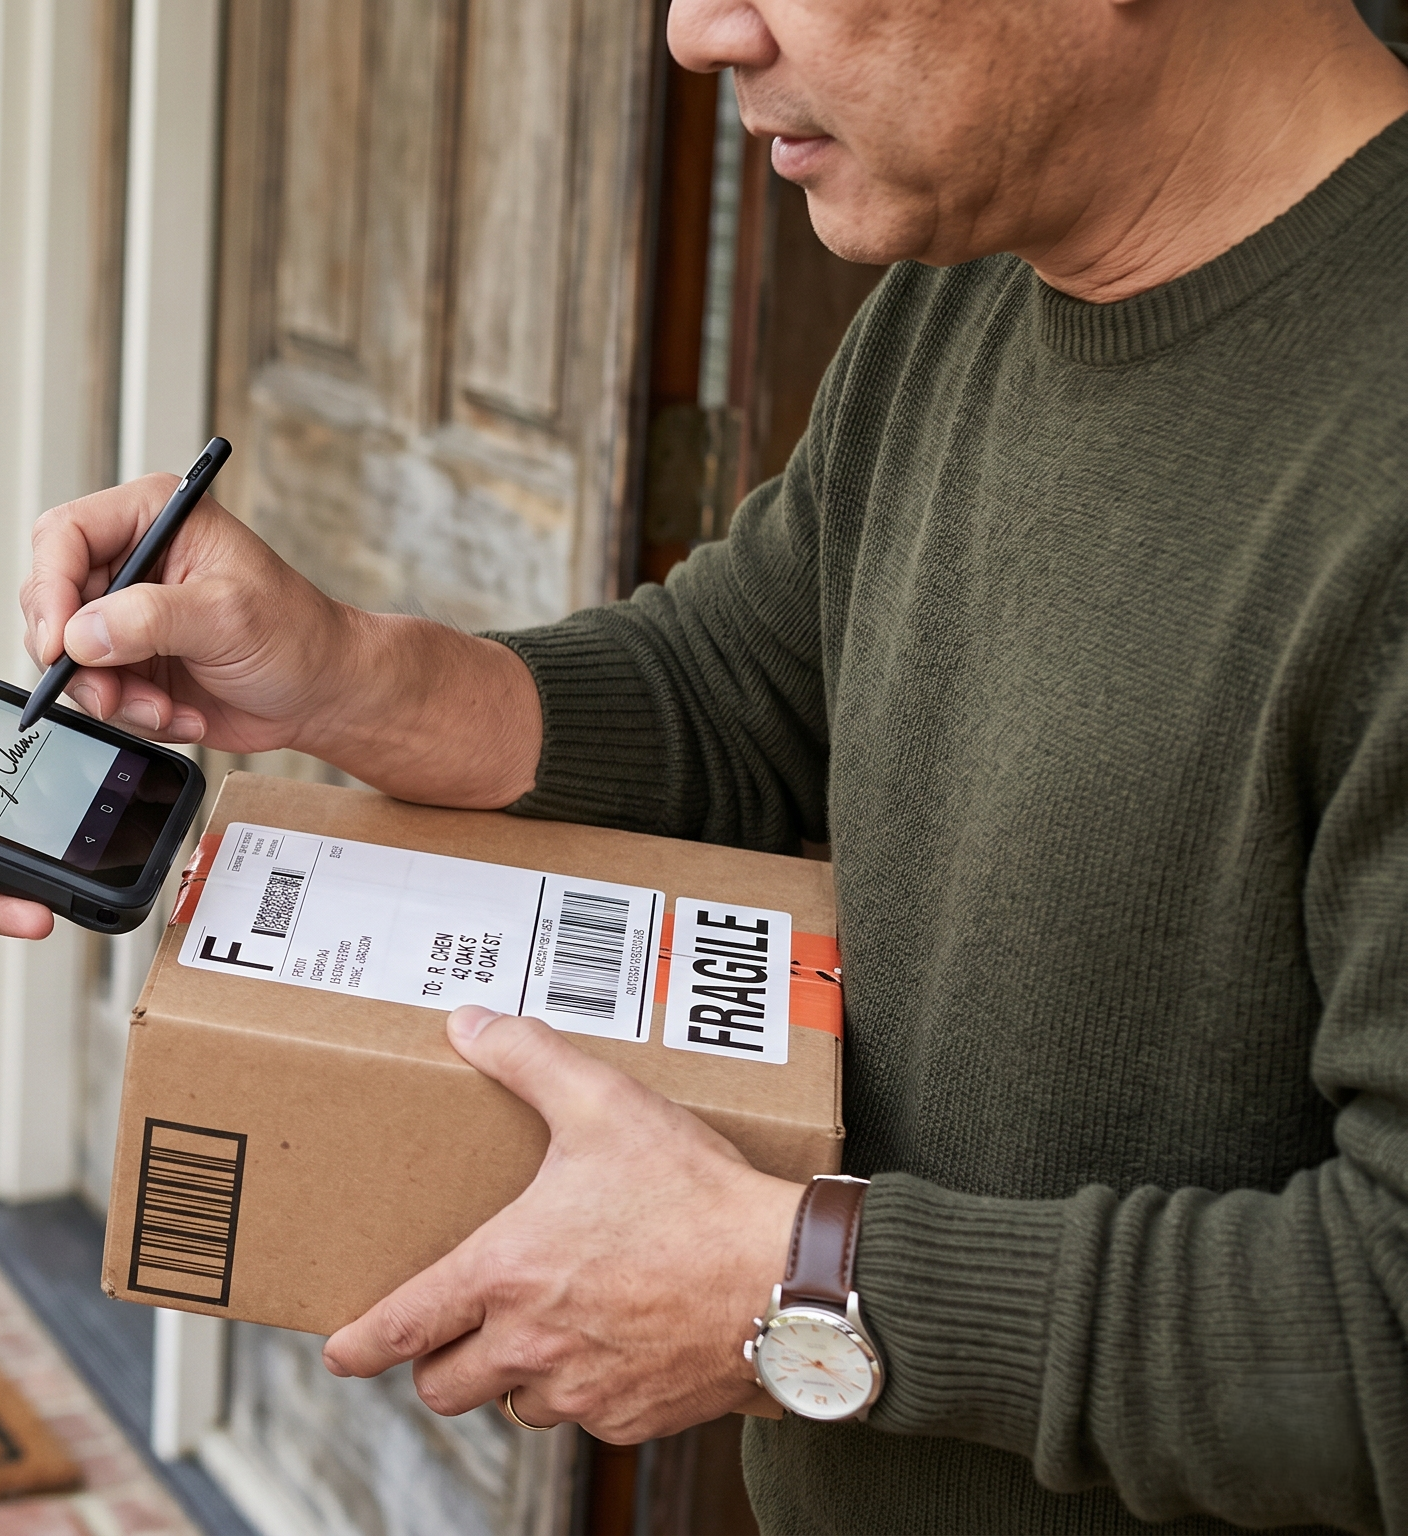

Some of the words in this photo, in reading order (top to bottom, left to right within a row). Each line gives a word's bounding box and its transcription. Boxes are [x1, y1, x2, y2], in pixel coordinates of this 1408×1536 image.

[199, 935, 274, 972] F
[430, 932, 454, 962] CHEN
[478, 946, 500, 968] OAK
[427, 966, 446, 975] R
[687, 909, 770, 1053] FRAGILE
[422, 980, 444, 996] TO:
